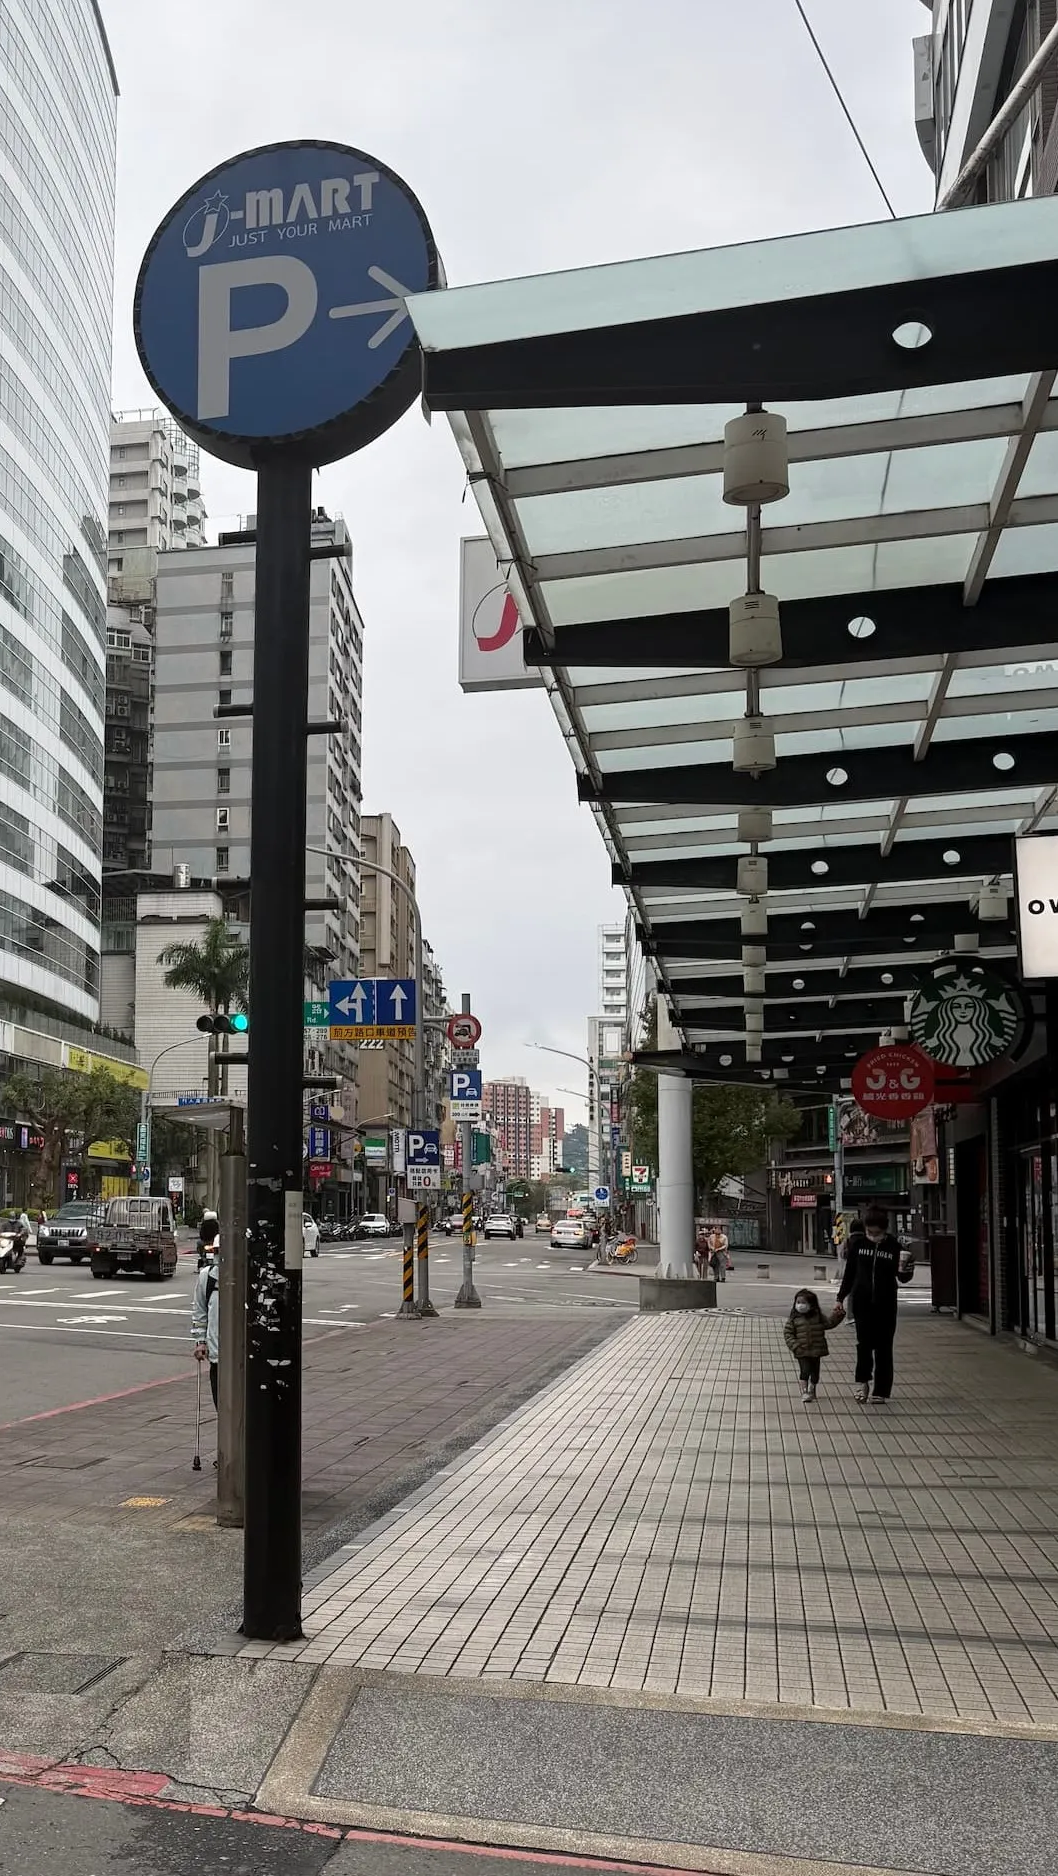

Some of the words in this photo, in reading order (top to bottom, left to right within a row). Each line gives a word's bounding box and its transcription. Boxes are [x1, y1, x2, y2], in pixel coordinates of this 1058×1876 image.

[229, 230, 266, 248] JUST
[277, 222, 318, 240] YOUR
[328, 213, 374, 232] MART
[197, 255, 318, 421] P
[333, 1028, 417, 1038] 前方路口車道預告
[359, 1040, 384, 1050] 222
[452, 1073, 471, 1097] P
[408, 1134, 425, 1158] P
